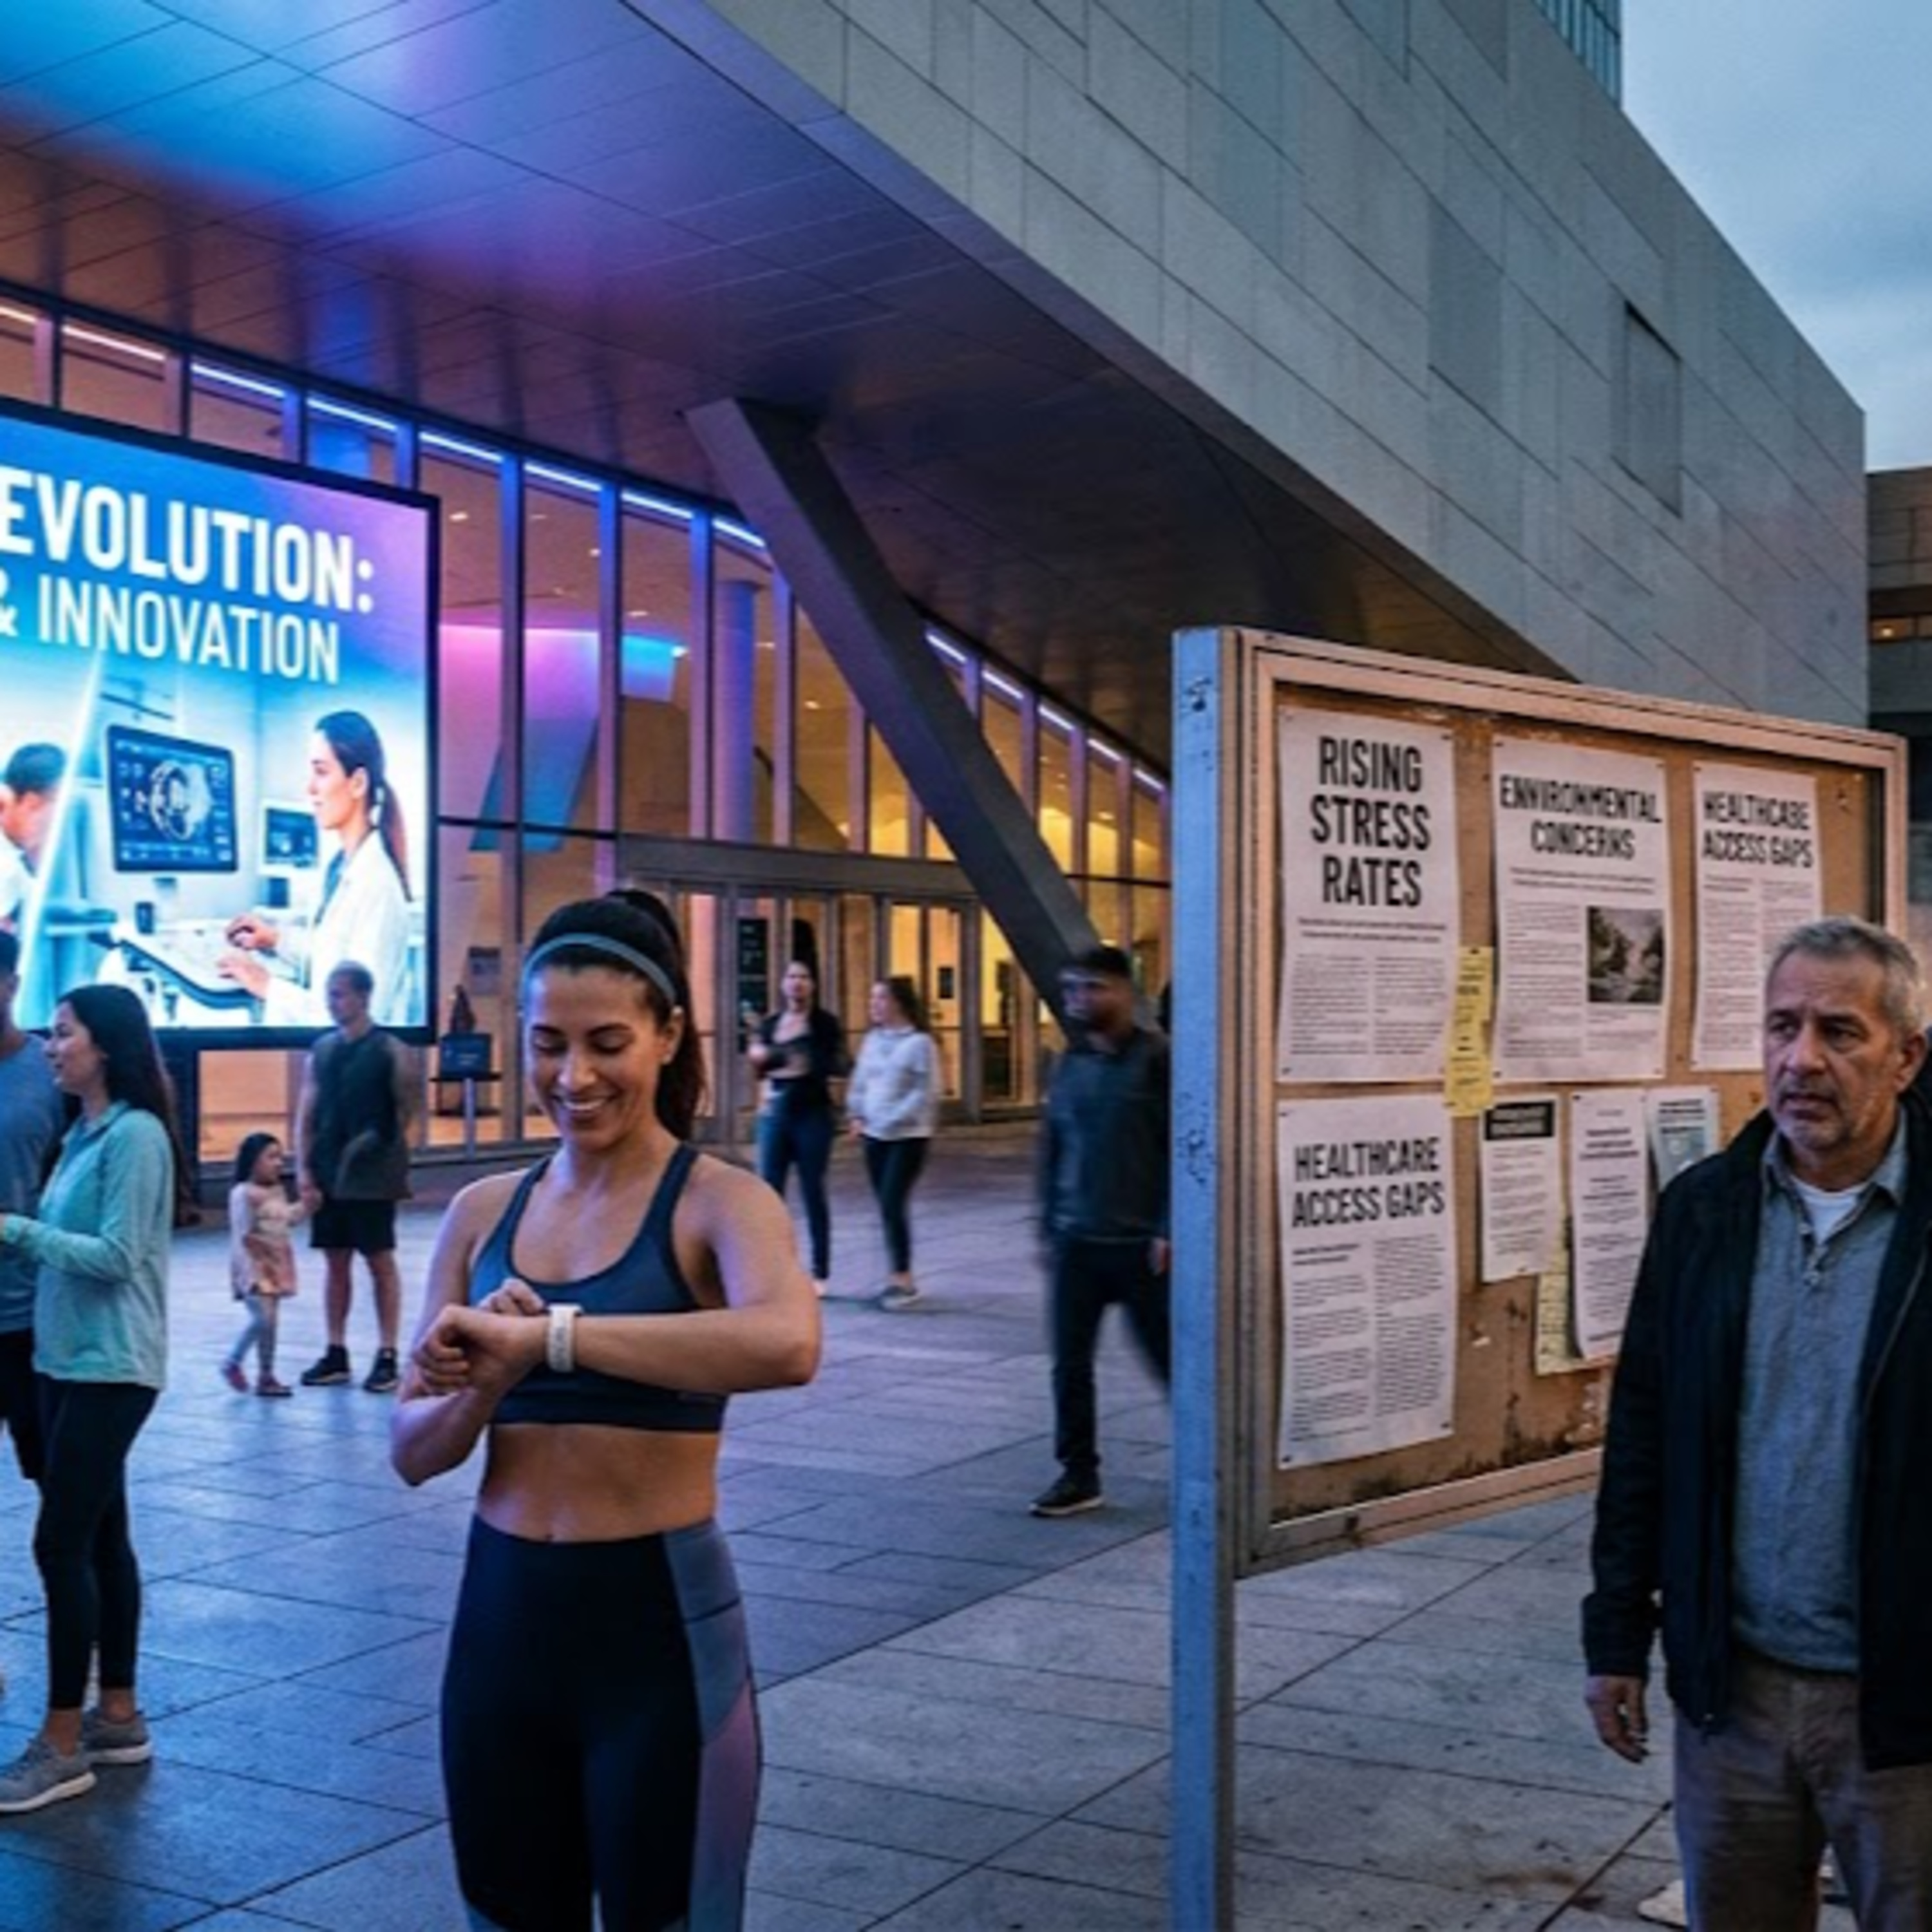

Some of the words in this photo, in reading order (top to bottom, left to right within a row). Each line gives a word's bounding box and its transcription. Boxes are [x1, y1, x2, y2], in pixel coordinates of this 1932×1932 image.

[0, 464, 374, 613] EVOLUTION:
[39, 573, 339, 684] INNOVATION
[1319, 735, 1422, 793] RISING
[1310, 794, 1431, 851] STRESS
[1703, 829, 1766, 864] ACCESS
[1322, 855, 1422, 907] RATES
[1294, 1136, 1441, 1182] HEALTHCARE
[1292, 1186, 1381, 1228] ACCESS
[1386, 1181, 1446, 1218] GAPS
